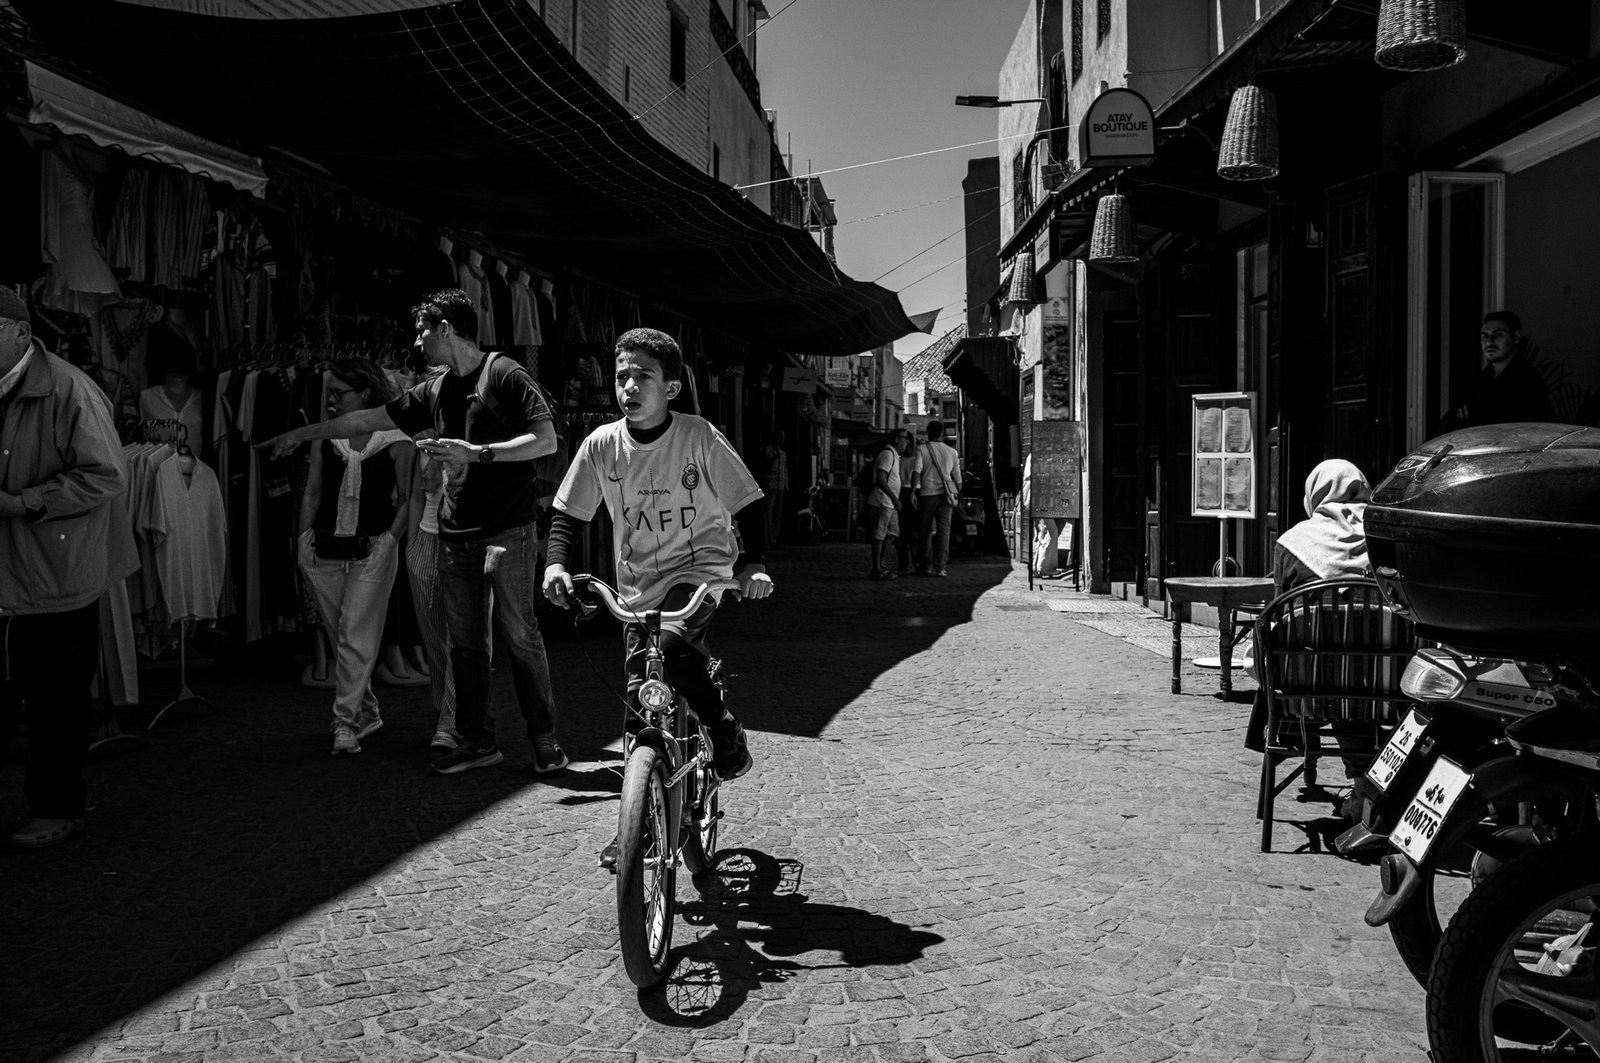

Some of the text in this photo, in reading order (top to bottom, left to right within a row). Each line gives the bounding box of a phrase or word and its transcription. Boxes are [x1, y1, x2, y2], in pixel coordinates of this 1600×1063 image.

[1093, 121, 1149, 133] BOUTIQUE
[1107, 113, 1133, 123] ATAY
[622, 506, 697, 532] KAFD
[1475, 687, 1555, 707] Super C50
[1399, 730, 1412, 747] 26
[1404, 804, 1438, 840] 000776
